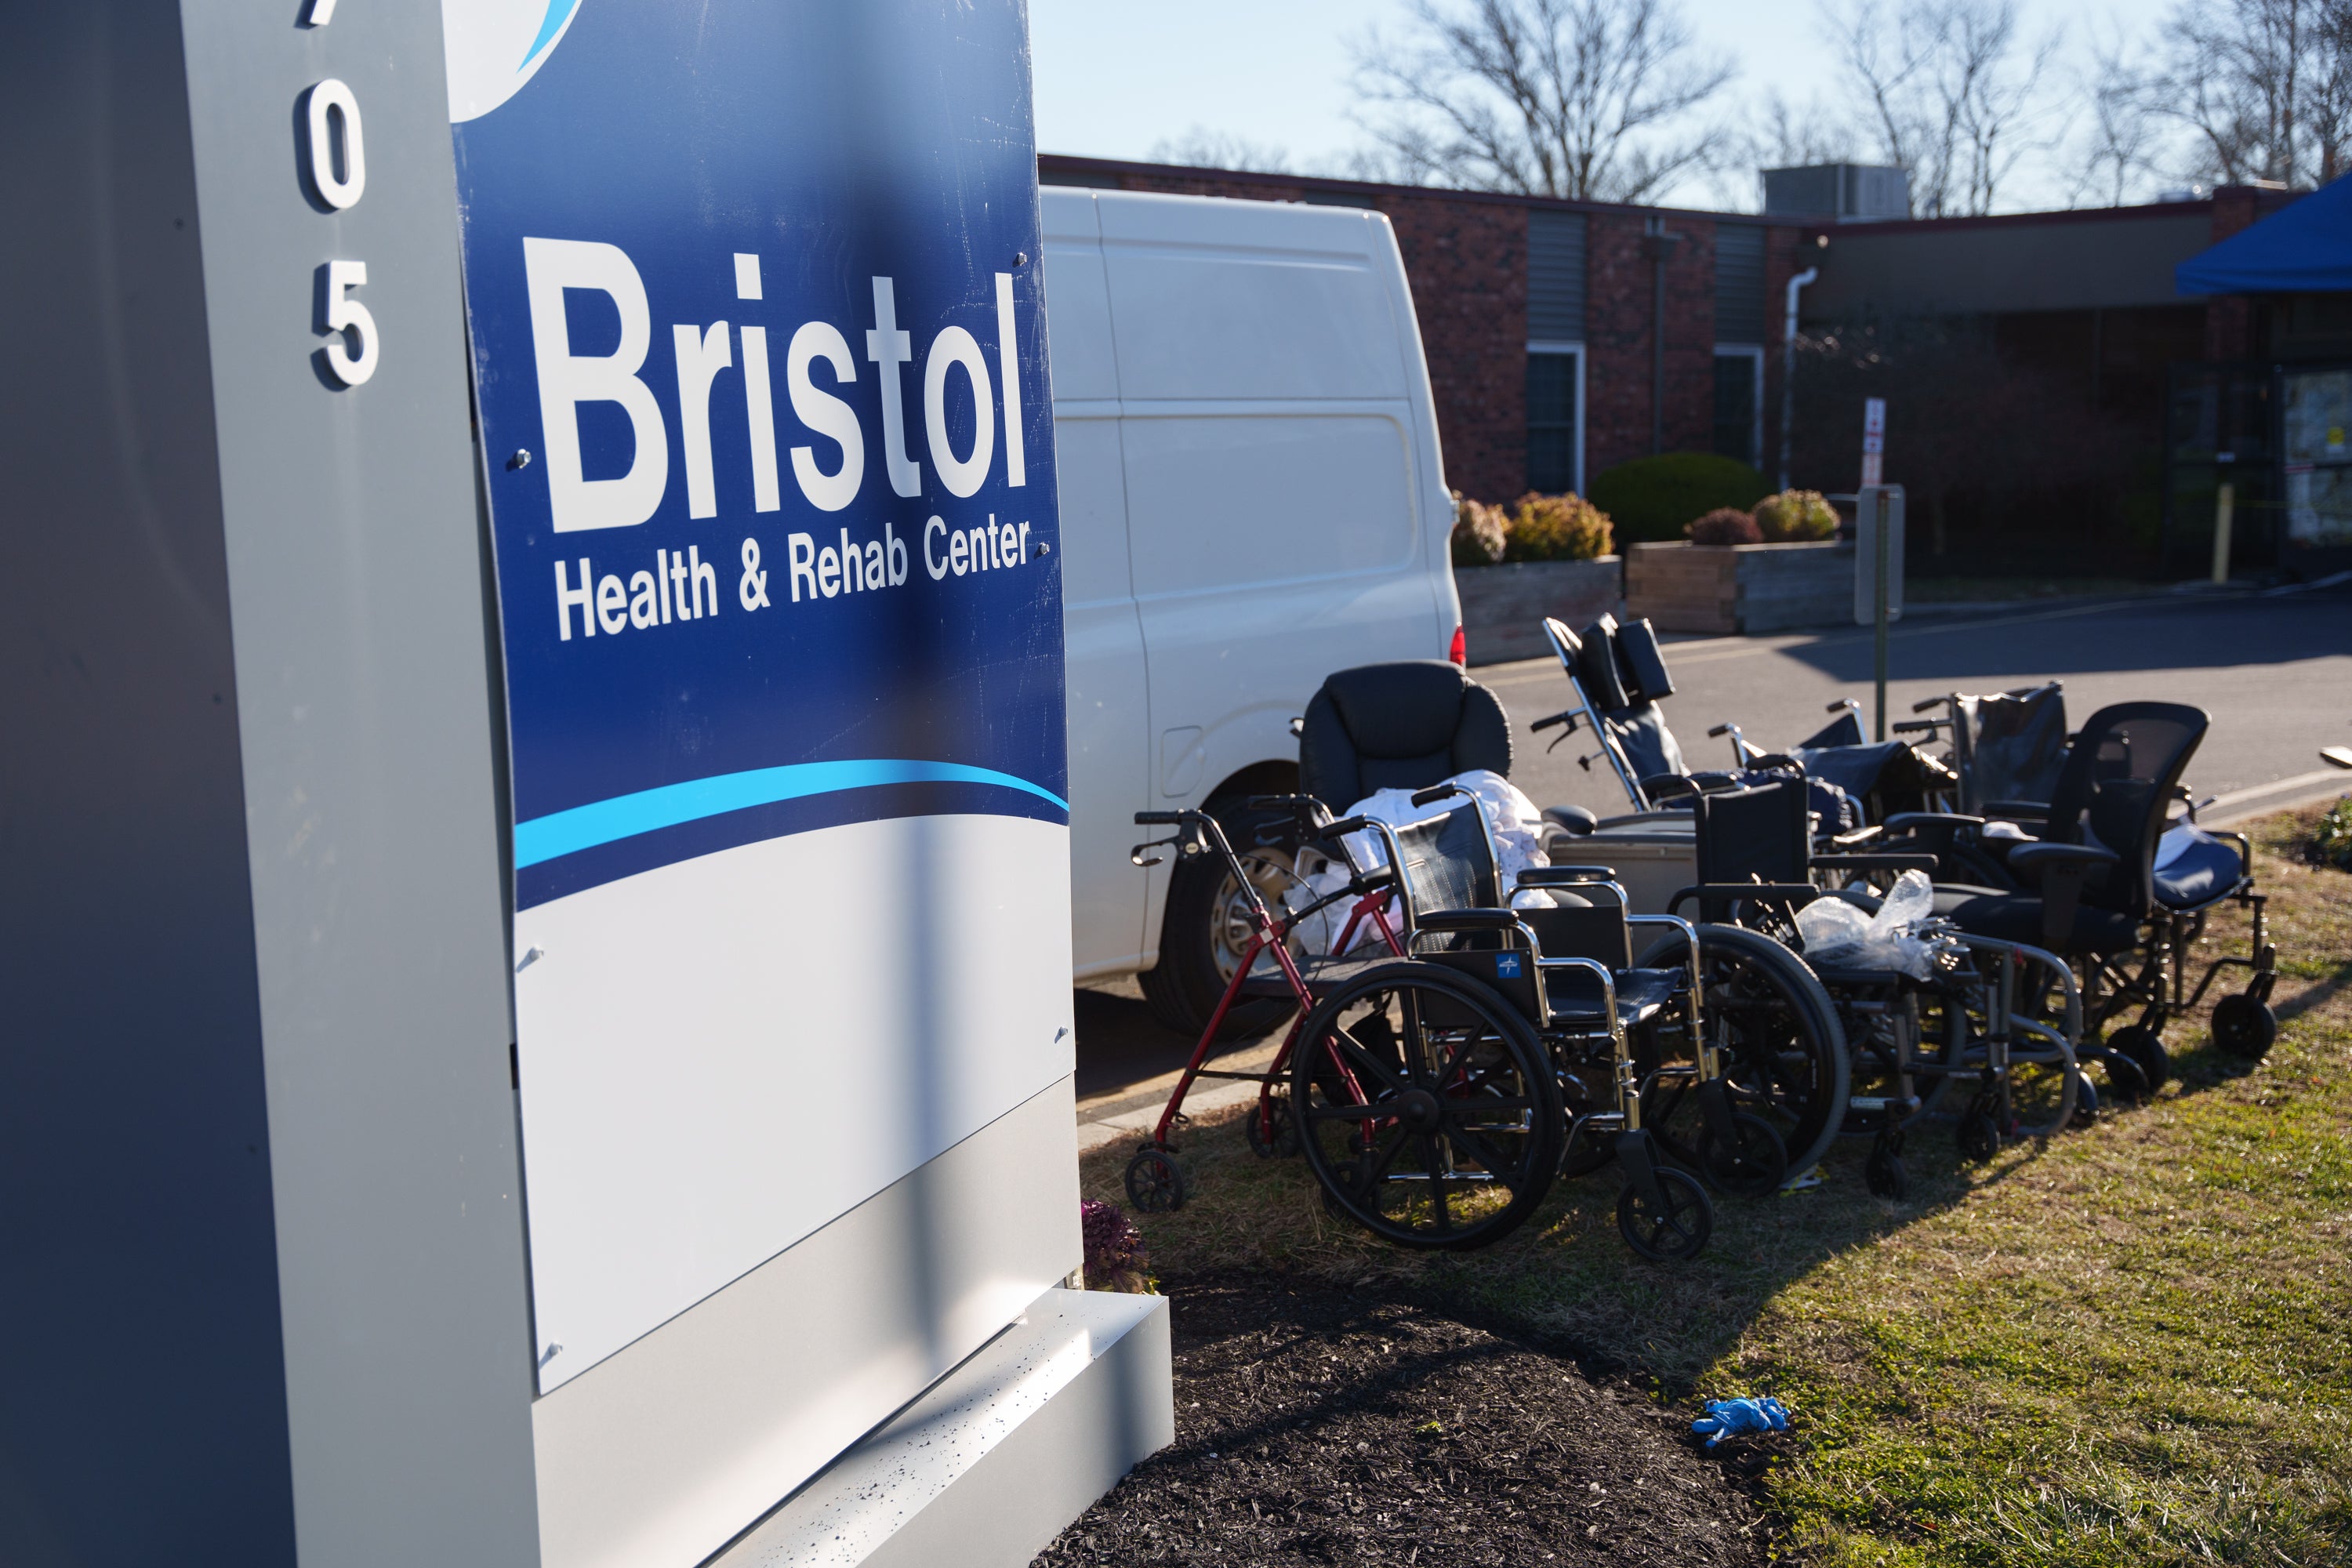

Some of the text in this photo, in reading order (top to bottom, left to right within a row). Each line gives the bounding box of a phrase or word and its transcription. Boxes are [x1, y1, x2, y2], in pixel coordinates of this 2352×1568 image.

[309, 0, 379, 386] 05
[522, 236, 1026, 534] Bristol
[554, 514, 1031, 641] Health & Rehab Center
